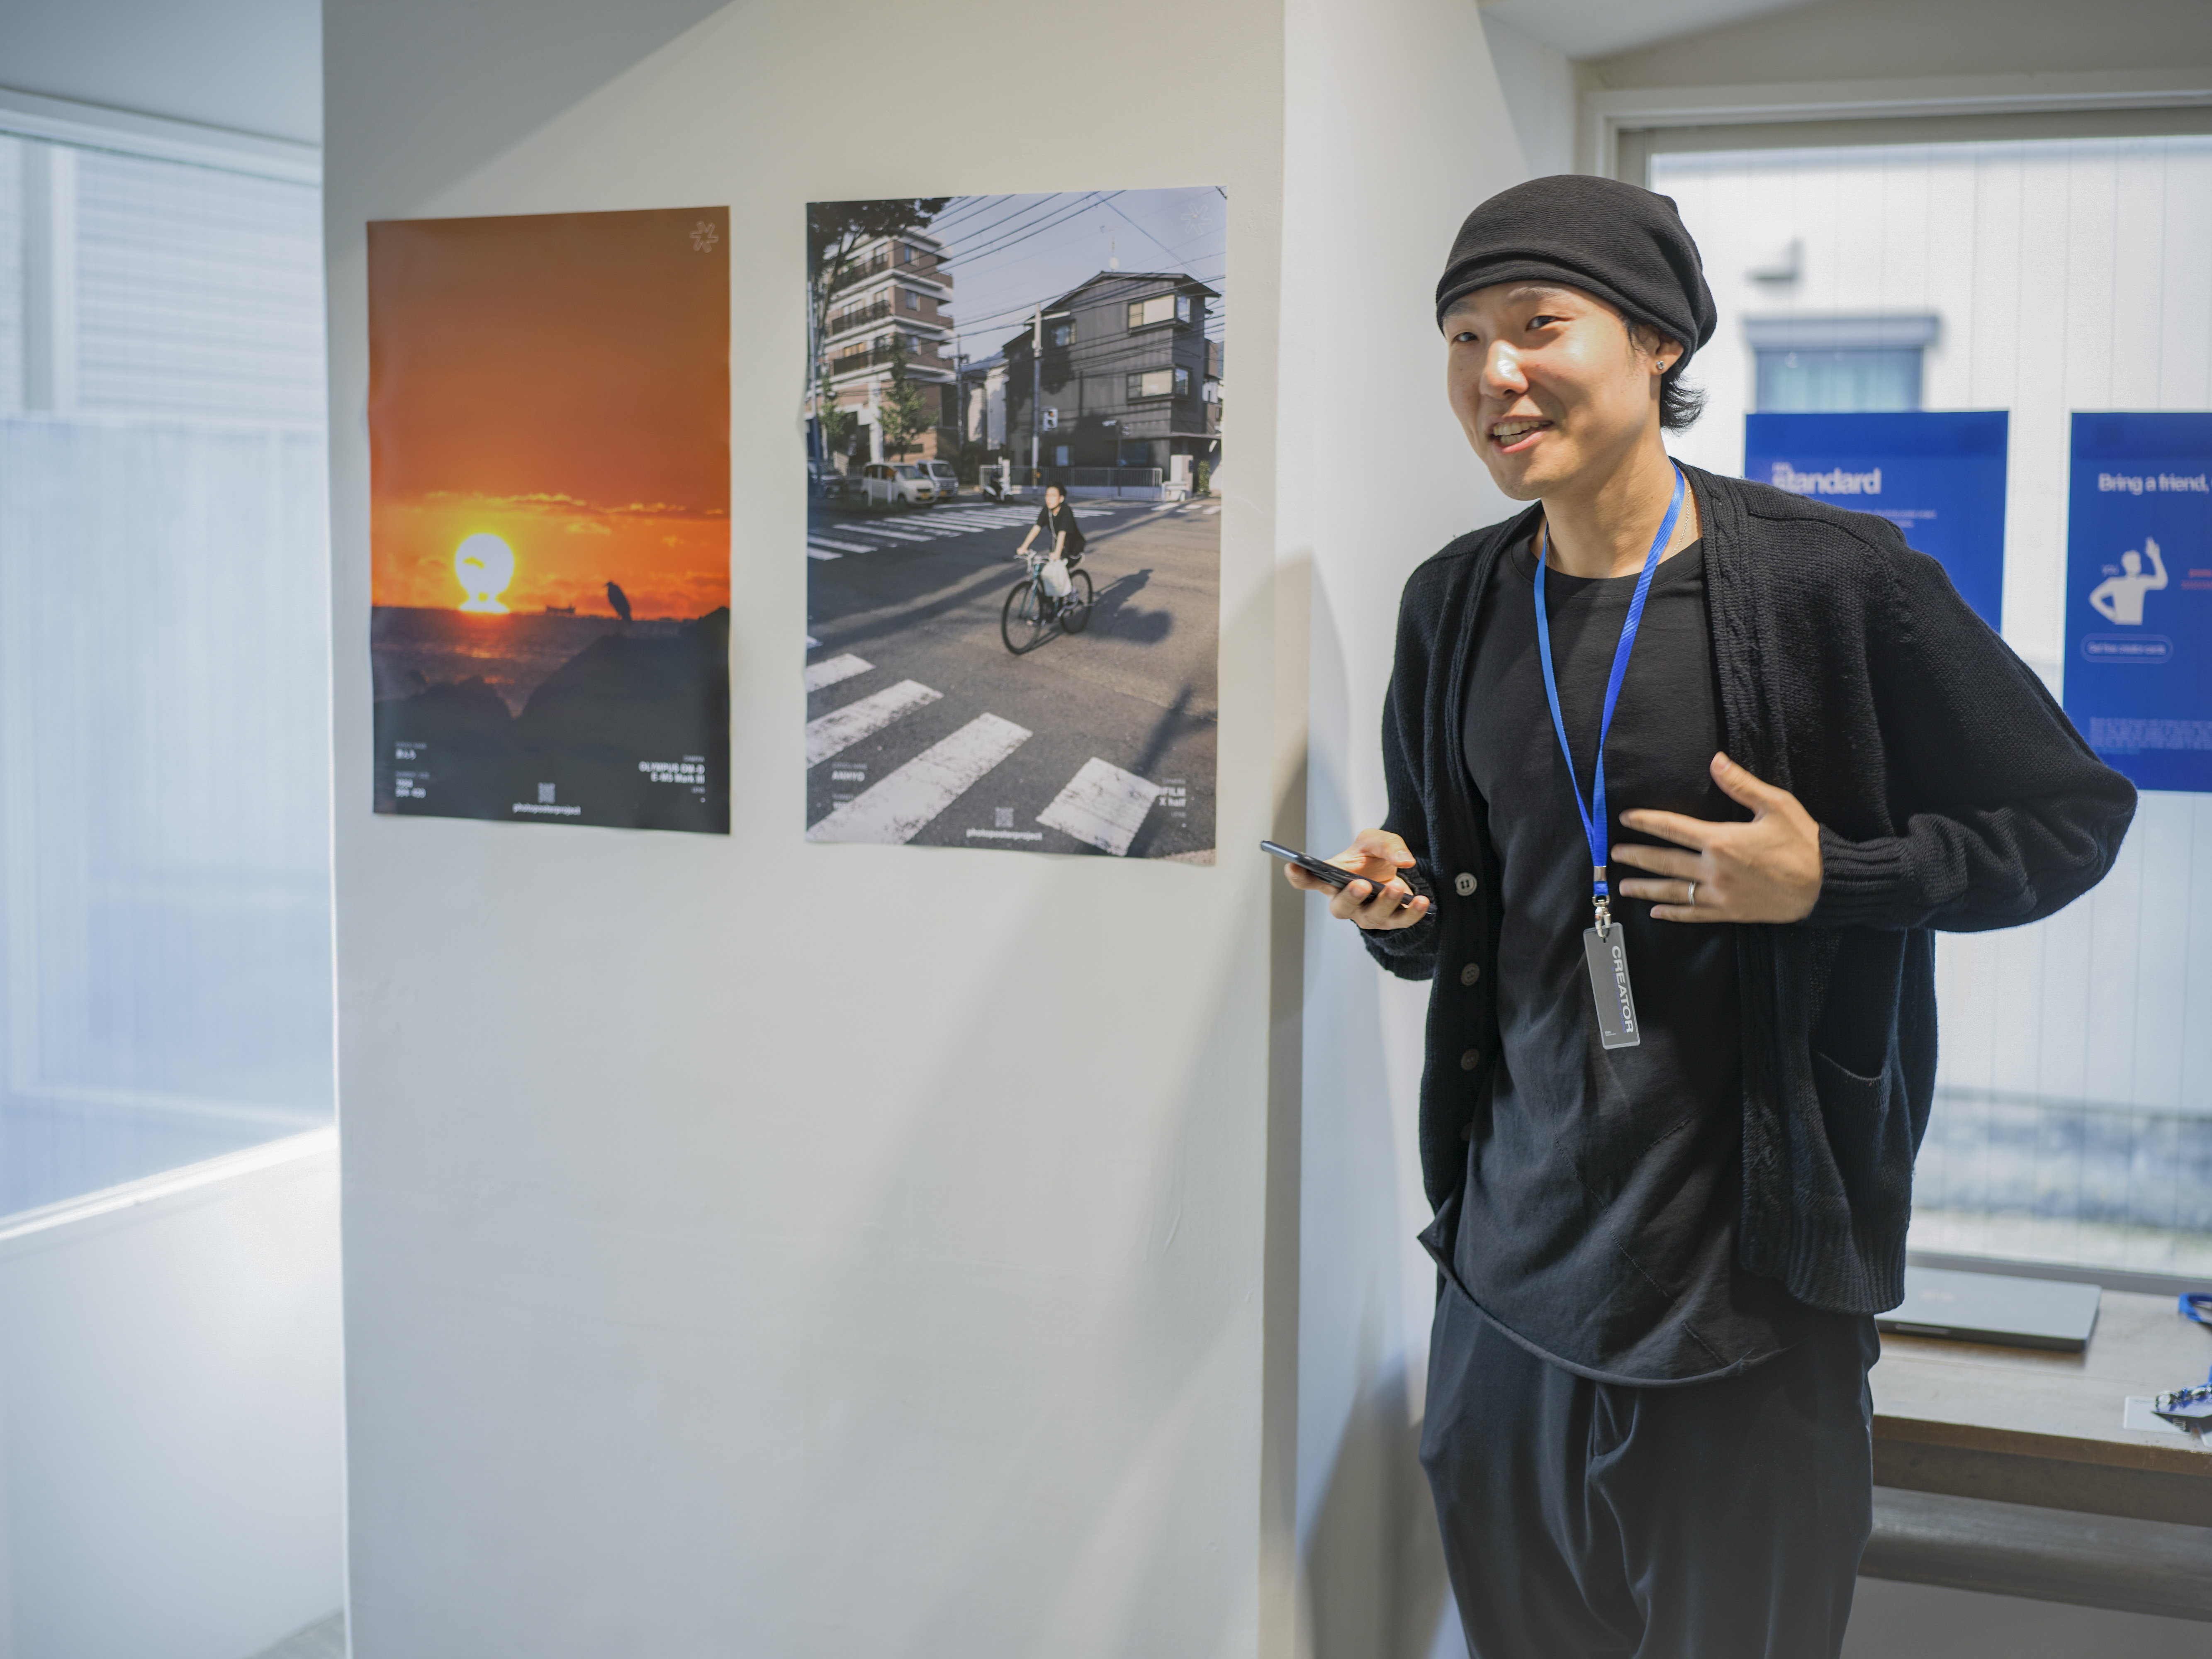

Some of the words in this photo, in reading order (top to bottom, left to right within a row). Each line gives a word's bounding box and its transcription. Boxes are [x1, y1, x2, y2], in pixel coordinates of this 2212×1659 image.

[2098, 473, 2143, 495] Bring
[2145, 477, 2156, 491] a
[639, 761, 679, 773] OLYMPUS
[680, 764, 705, 774] OM-D
[651, 772, 674, 783] E-M5
[674, 773, 695, 783] Mark
[1159, 797, 1166, 806] X
[1168, 797, 1186, 807] half
[1611, 946, 1634, 1033] CREATOR
